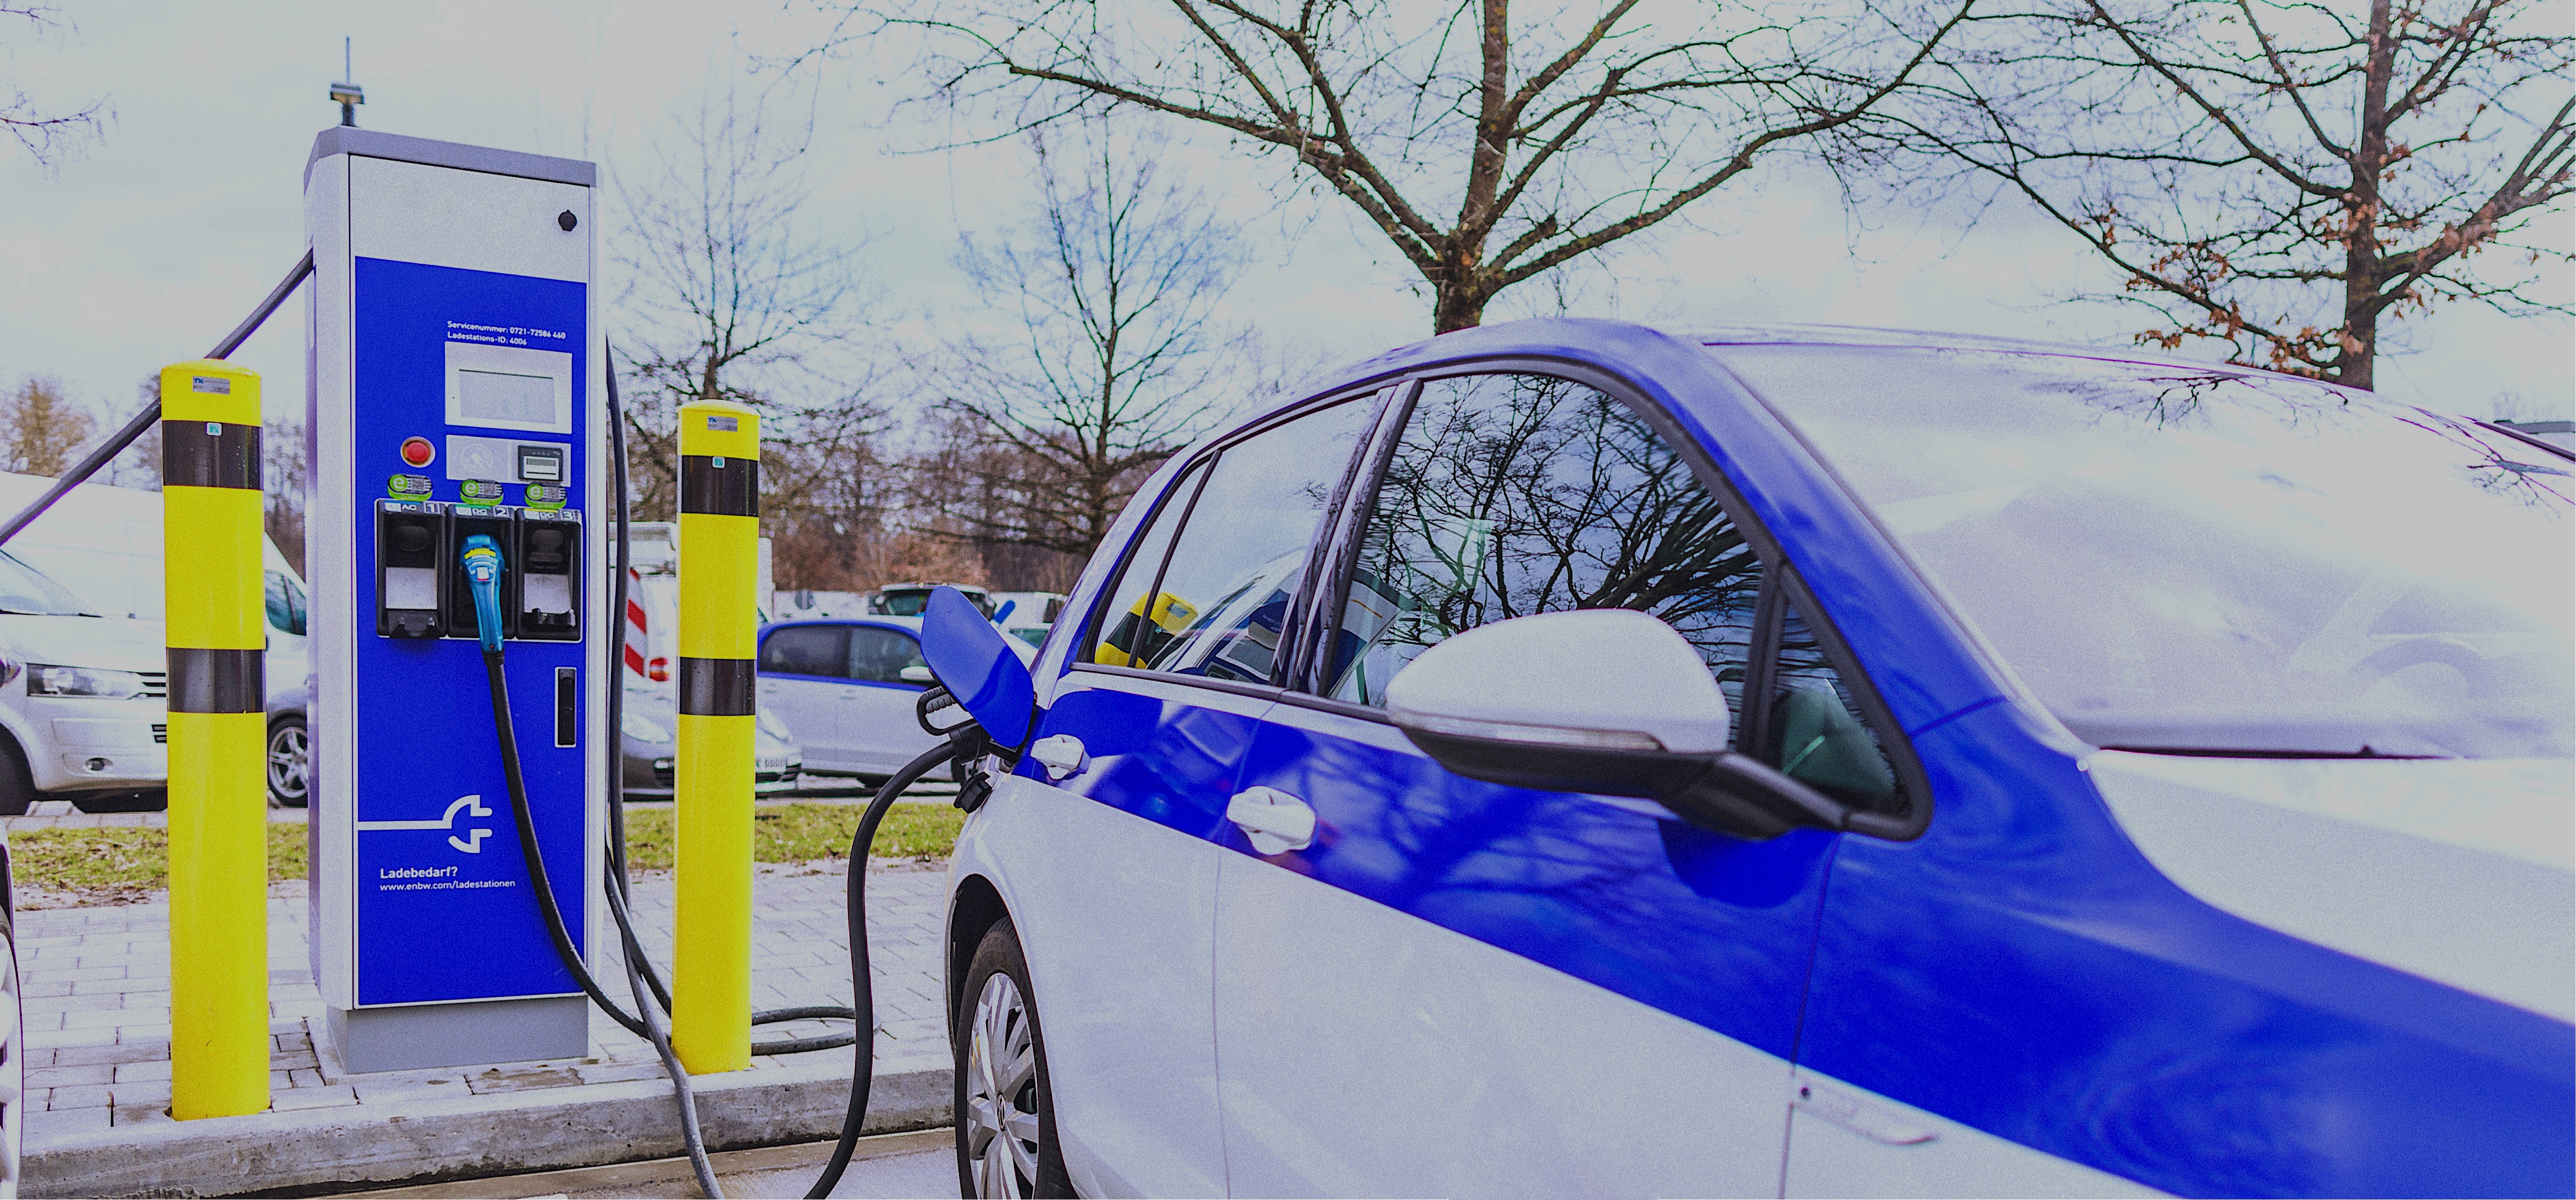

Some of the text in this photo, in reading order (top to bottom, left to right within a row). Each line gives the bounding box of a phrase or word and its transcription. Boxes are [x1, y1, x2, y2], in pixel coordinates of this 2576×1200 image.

[447, 321, 508, 333] Servicenummer:
[552, 331, 566, 339] 460
[447, 331, 527, 346] Ladestations-ID: 4006
[426, 504, 435, 514] 1
[495, 507, 508, 517] 2
[563, 511, 574, 521] 3
[380, 866, 458, 879] Ladebedarf?
[379, 879, 516, 891] www.enbw.com/ladestationen
